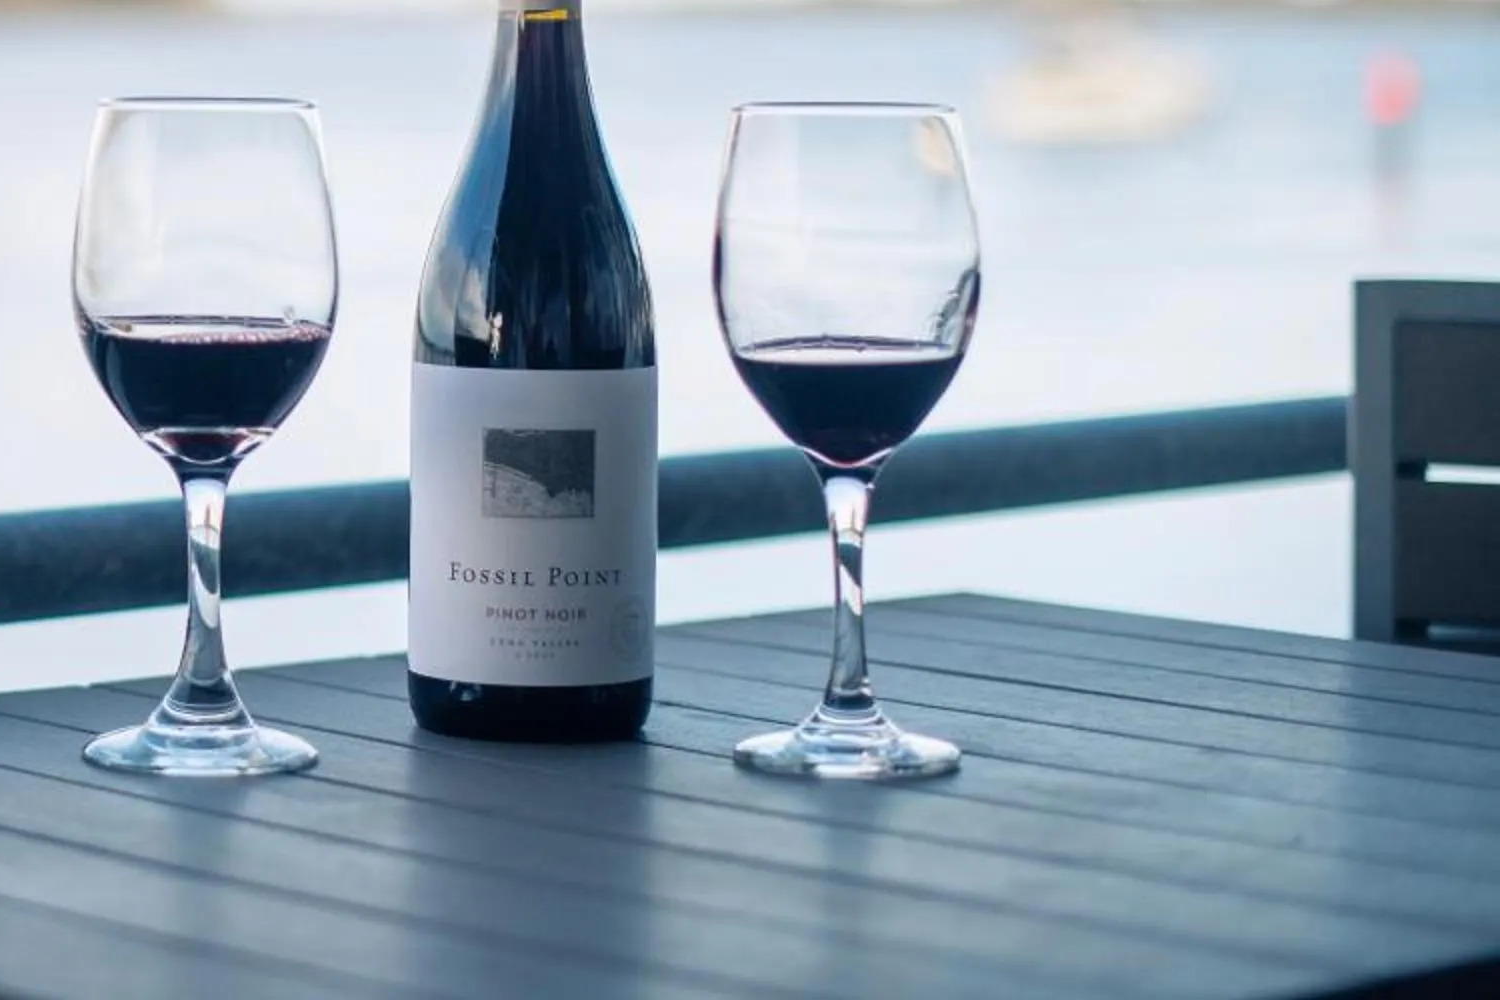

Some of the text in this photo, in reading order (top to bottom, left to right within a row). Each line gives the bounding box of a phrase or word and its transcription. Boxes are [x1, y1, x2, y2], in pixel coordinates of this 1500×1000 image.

[449, 561, 622, 587] FOSSIL POINT
[485, 607, 588, 621] PINOT NOIR
